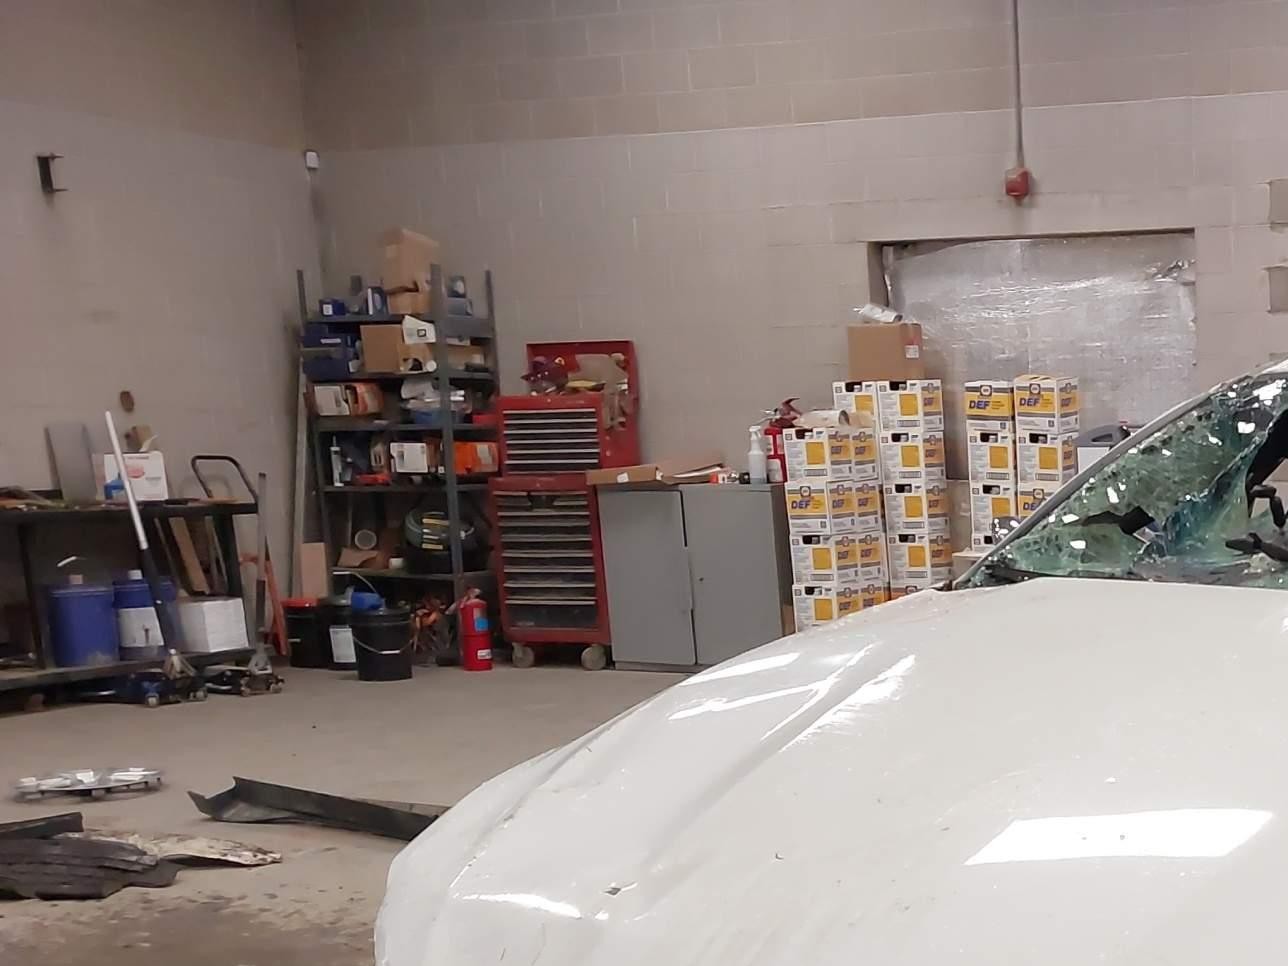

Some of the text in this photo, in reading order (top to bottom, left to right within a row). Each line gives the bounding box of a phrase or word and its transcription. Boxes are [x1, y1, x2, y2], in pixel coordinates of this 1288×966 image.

[969, 399, 992, 410] DEF
[1019, 397, 1041, 408] DEF
[791, 499, 812, 510] DEF
[1022, 501, 1038, 511] DE
